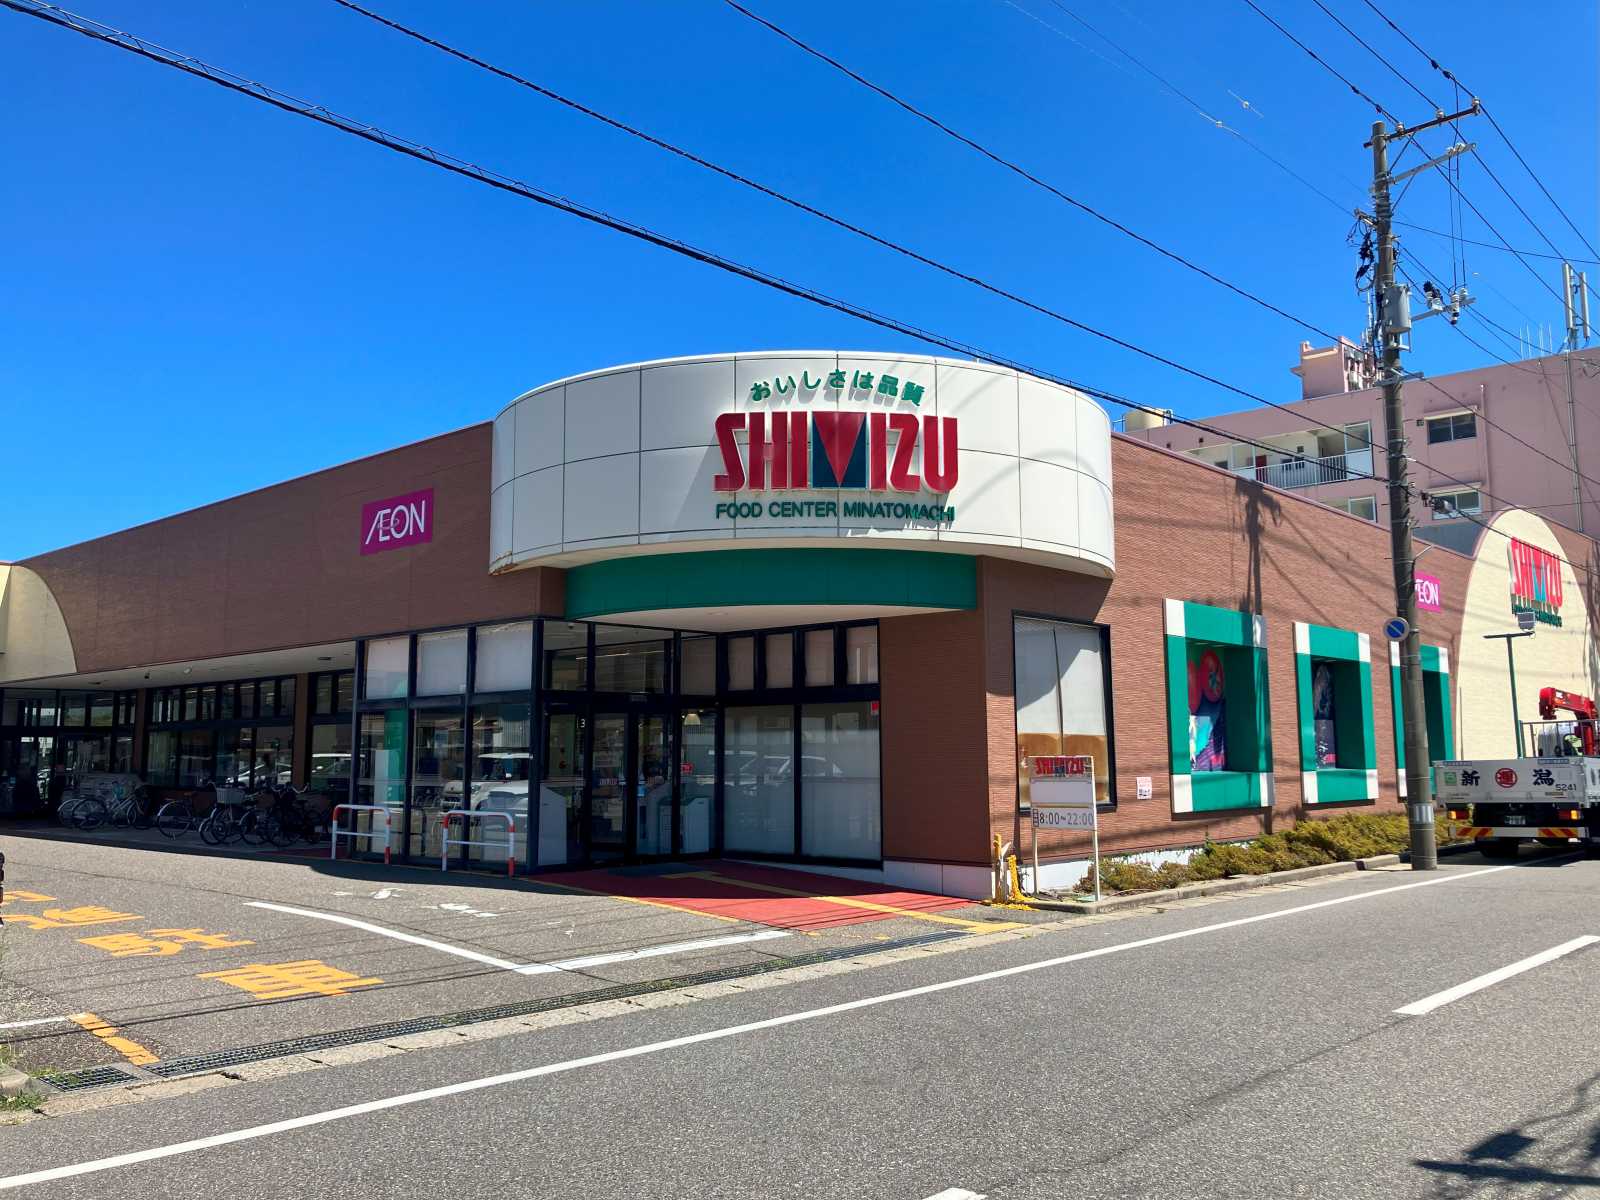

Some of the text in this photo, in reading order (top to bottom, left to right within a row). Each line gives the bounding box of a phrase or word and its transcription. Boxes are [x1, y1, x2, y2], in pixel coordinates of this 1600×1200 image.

[750, 369, 926, 406] おいしさは品質
[714, 411, 959, 494] SHIMIZU
[715, 501, 956, 522] FOOD CENTER MINATOMACHI
